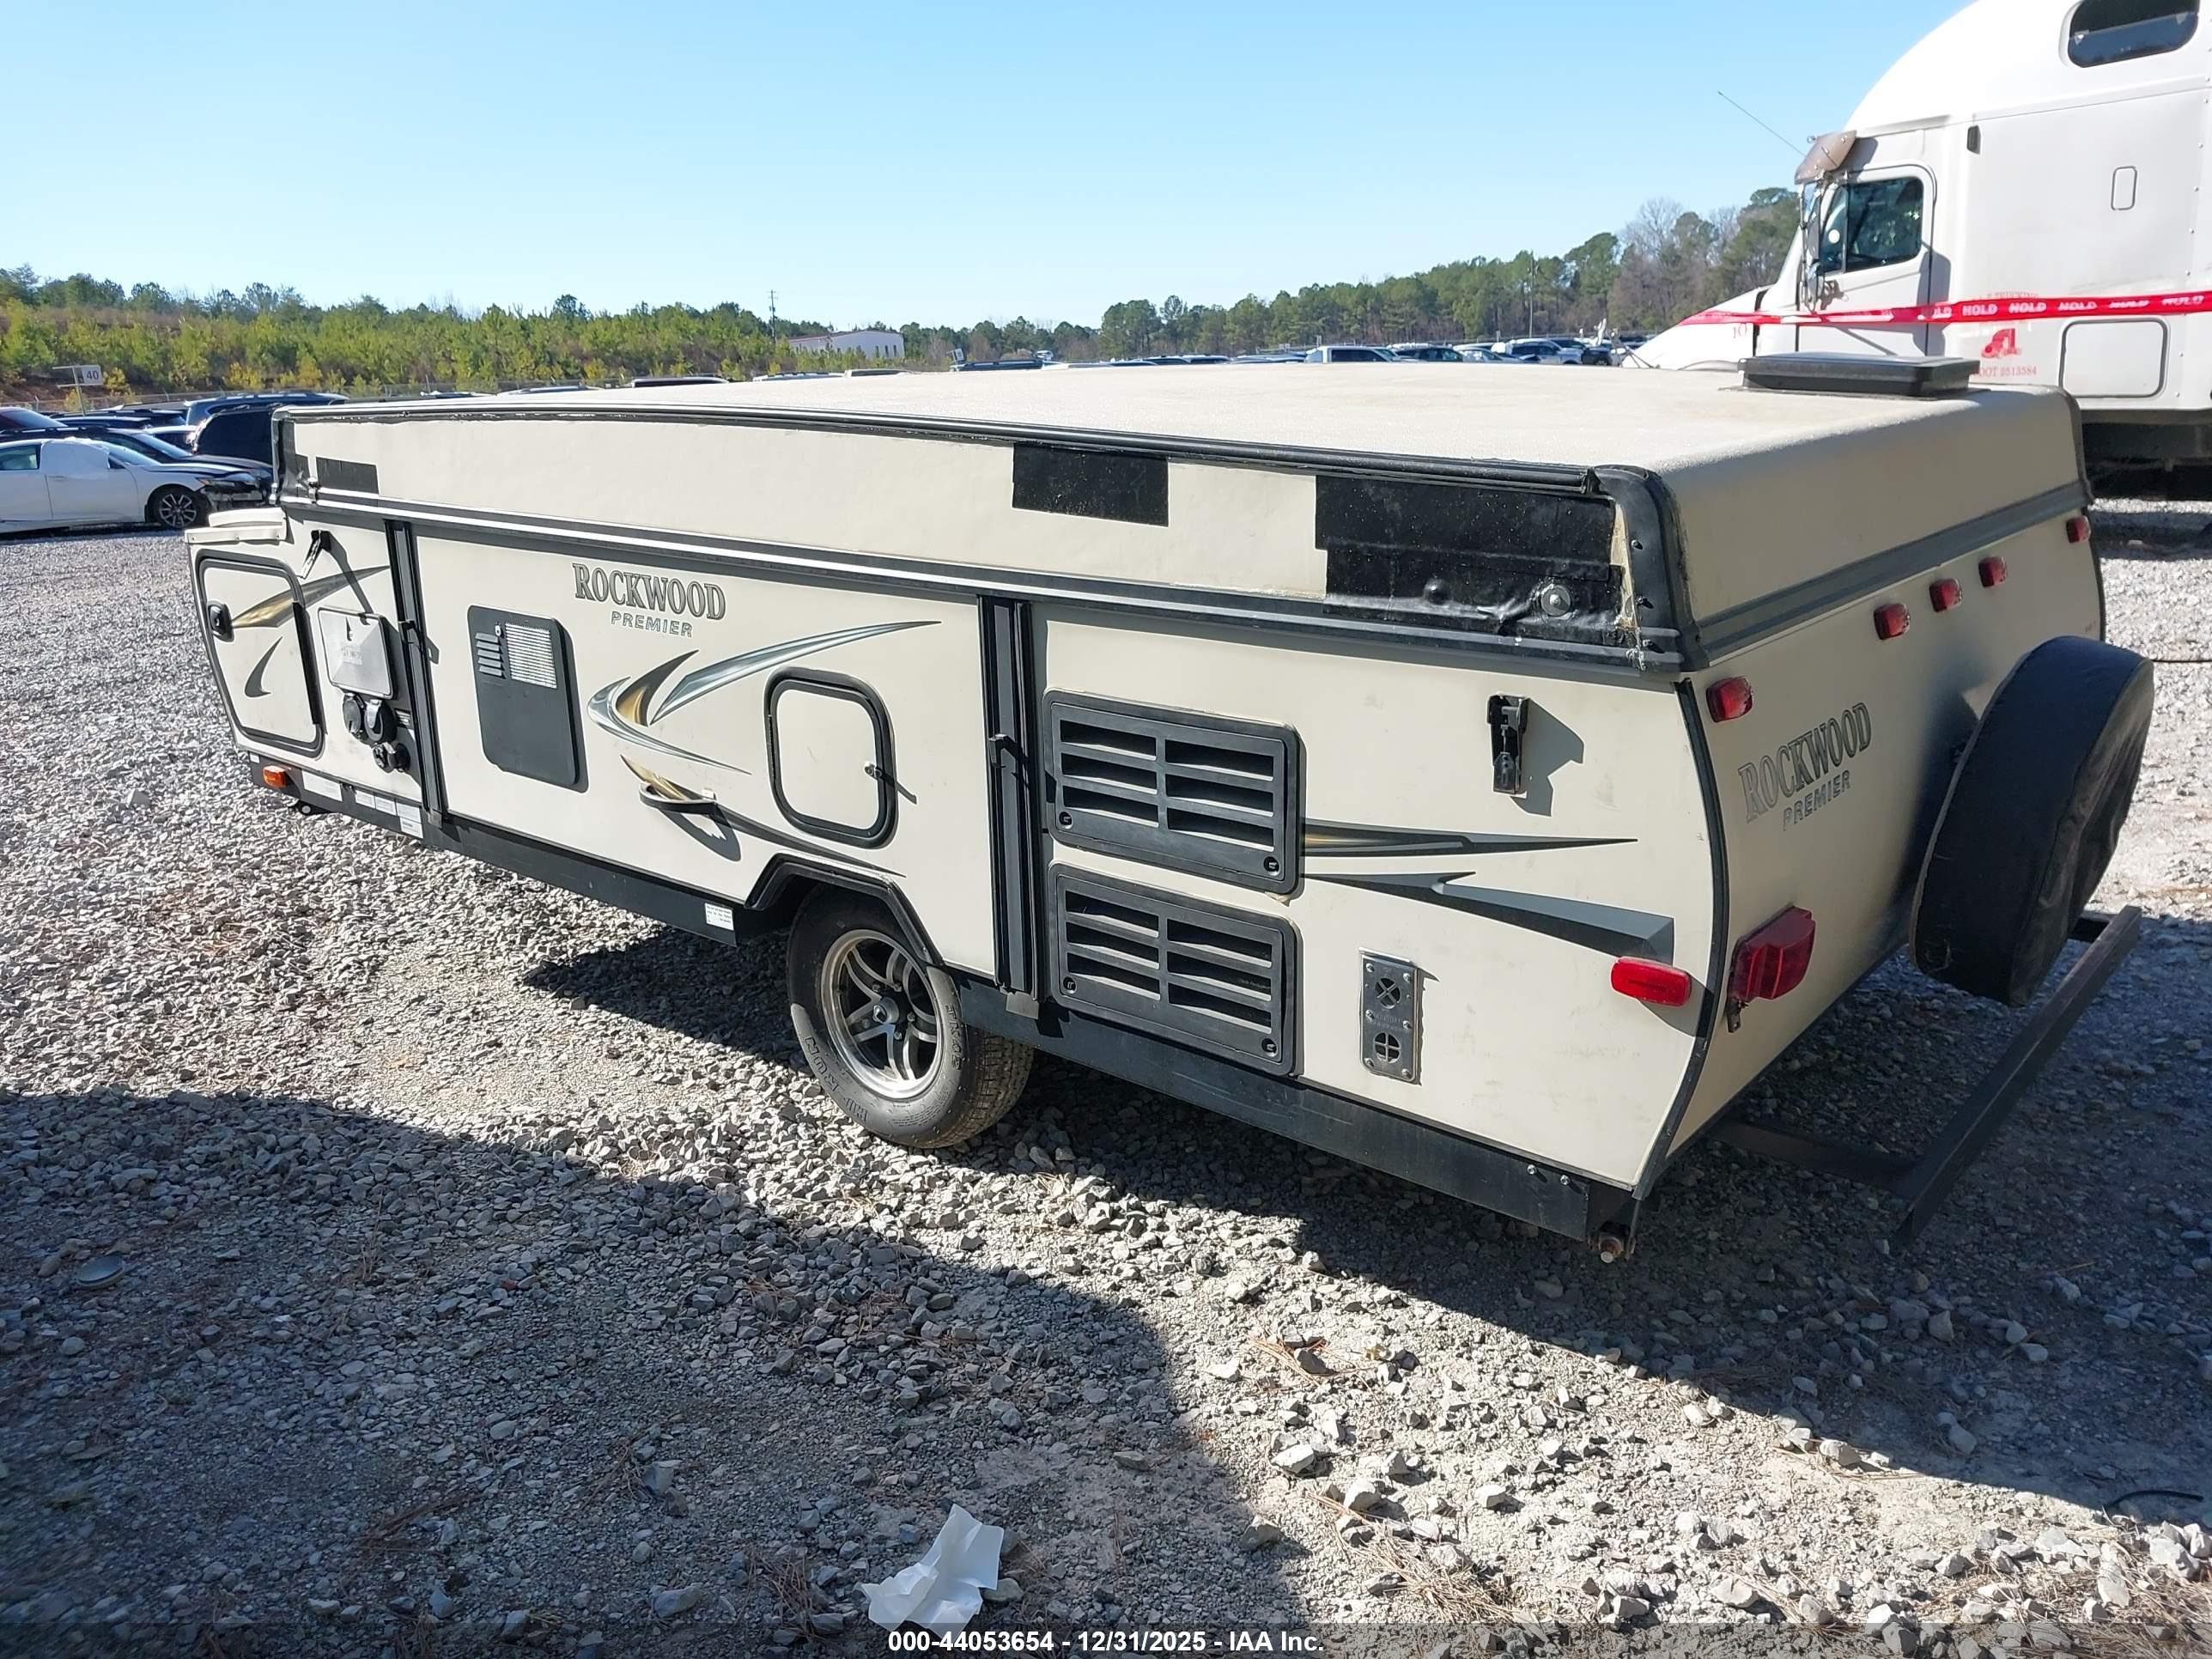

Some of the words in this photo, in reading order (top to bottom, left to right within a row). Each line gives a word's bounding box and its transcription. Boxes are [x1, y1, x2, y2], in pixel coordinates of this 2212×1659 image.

[1962, 303, 1998, 316] HOLD
[2008, 301, 2047, 313] HOLD
[2058, 301, 2098, 311] HOLD
[86, 370, 100, 380] 40
[572, 563, 726, 621] ROCKWOOD
[611, 611, 693, 638] PREMIER
[1737, 702, 1872, 824] ROCKWOOD
[1783, 769, 1851, 831] PREMIER
